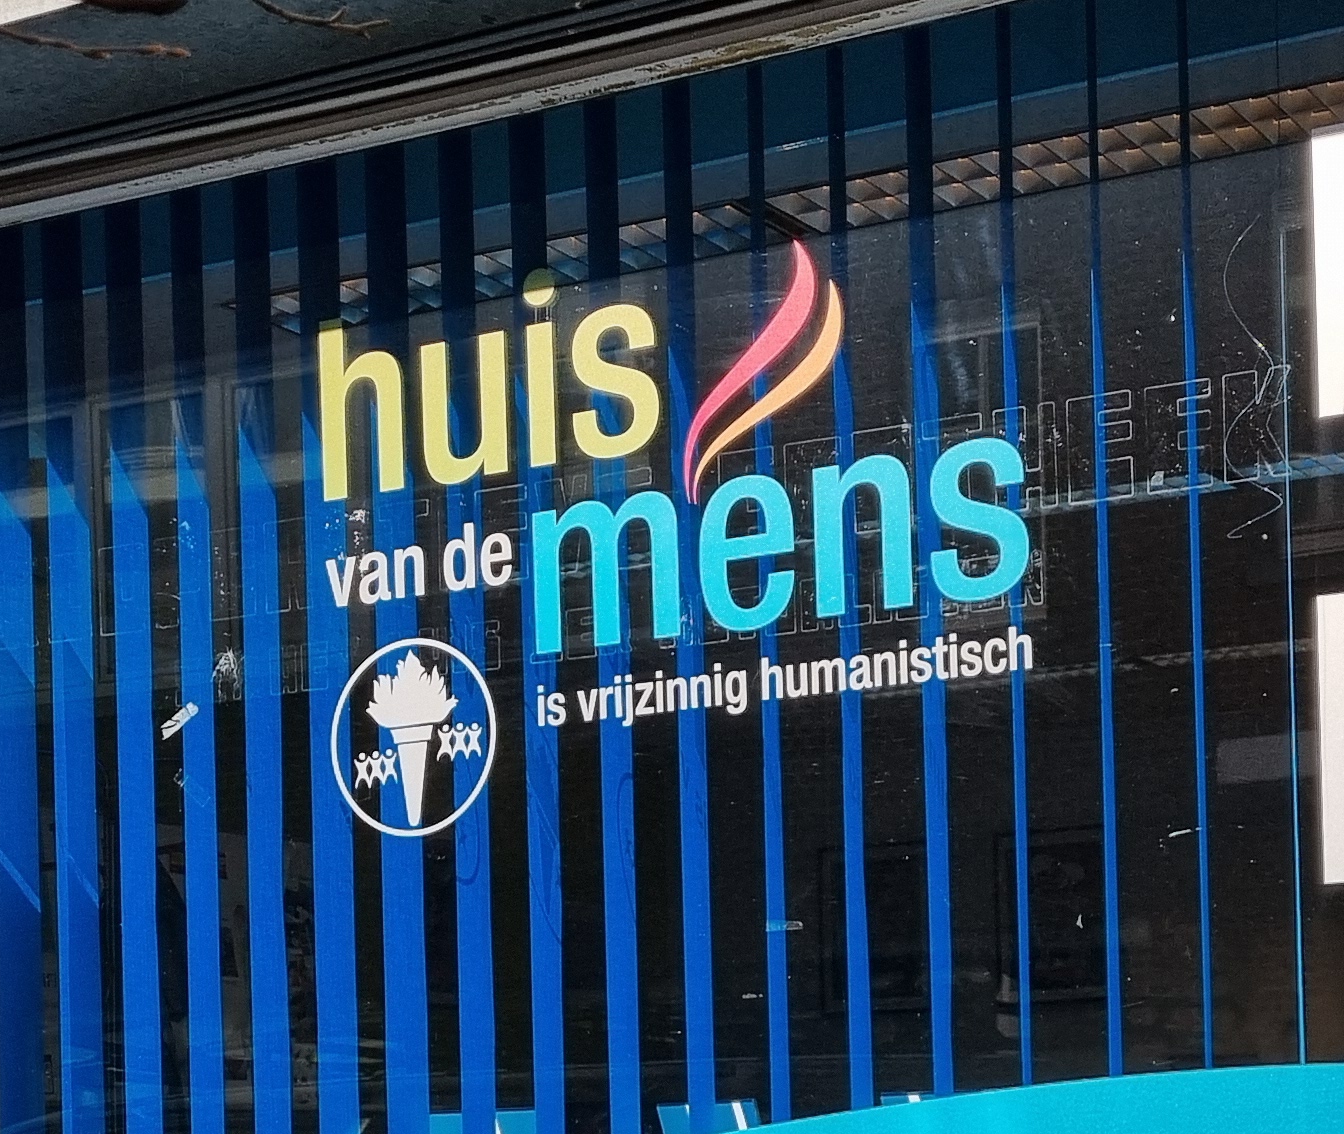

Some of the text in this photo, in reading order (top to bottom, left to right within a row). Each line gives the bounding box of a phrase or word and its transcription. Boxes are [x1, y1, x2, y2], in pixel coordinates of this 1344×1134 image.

[318, 269, 659, 502] huis
[326, 438, 1031, 655] van de mens
[536, 626, 1034, 727] is vrijzinnig humanistisch
